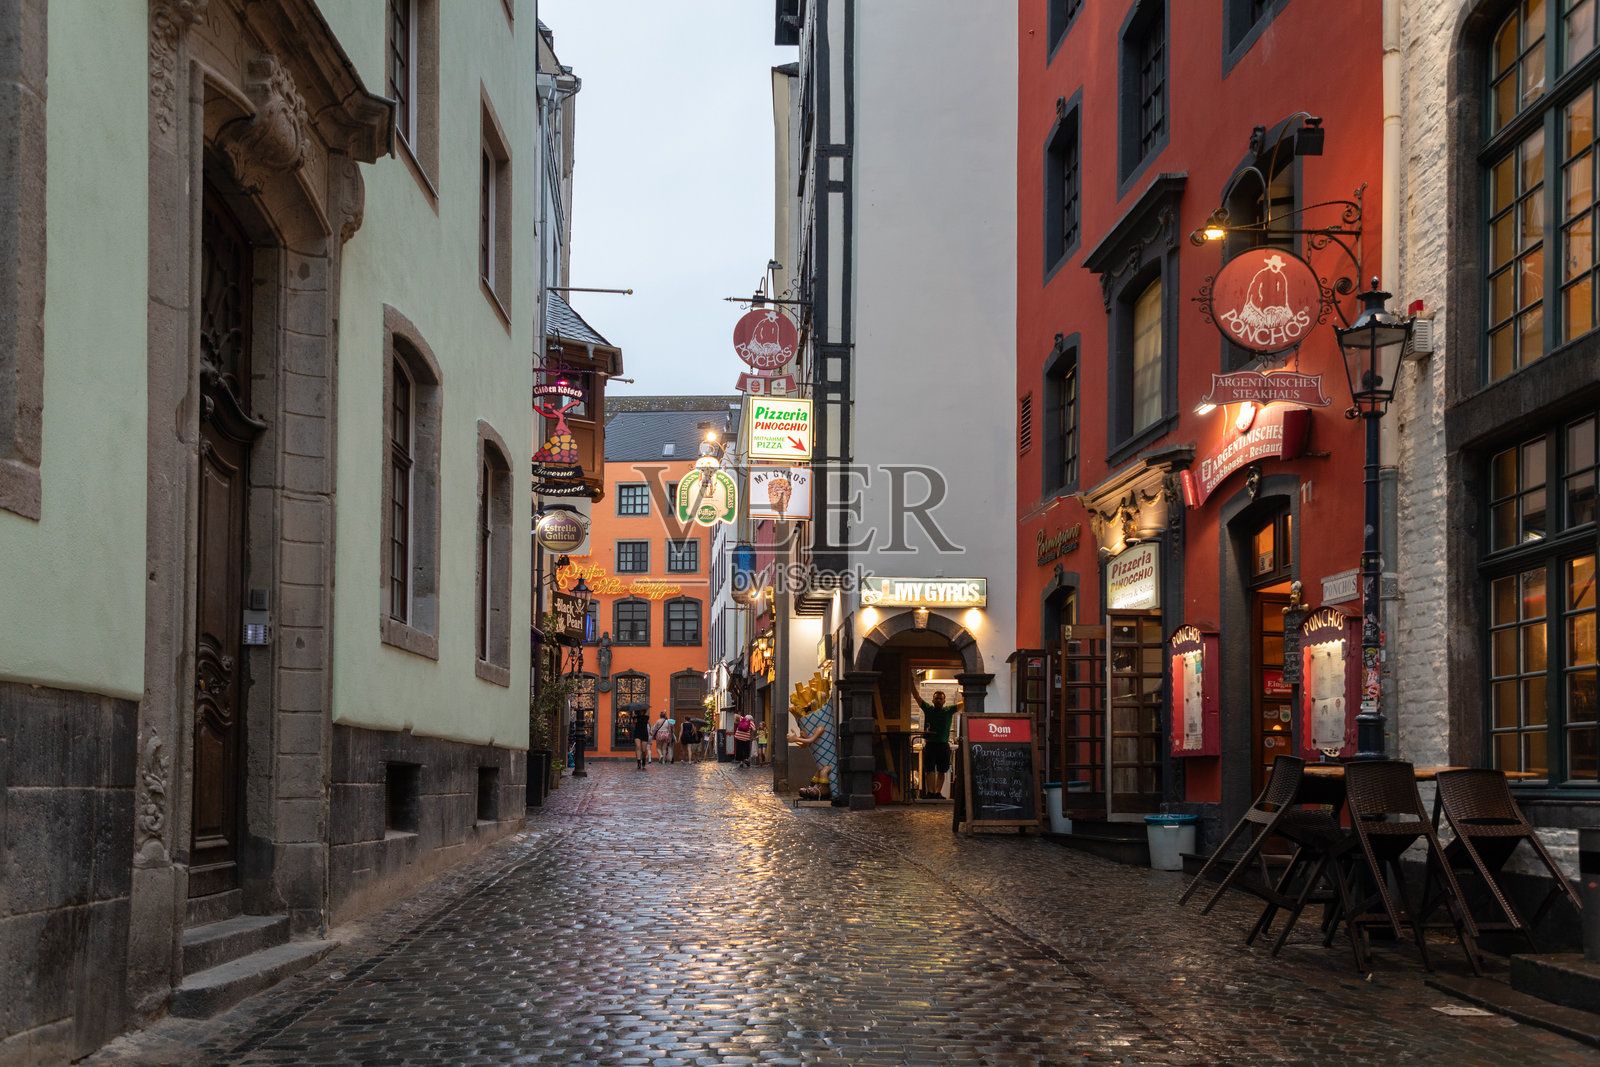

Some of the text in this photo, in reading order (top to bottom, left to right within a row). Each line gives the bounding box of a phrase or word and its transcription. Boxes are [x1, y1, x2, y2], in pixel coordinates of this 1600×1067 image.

[1216, 377, 1317, 388] ARGENTINISCHES
[1232, 389, 1300, 400] STEAKHAUS
[755, 406, 808, 421] Pizzeria
[754, 421, 808, 432] PINOCCHIO
[757, 441, 783, 449] PIZZA
[534, 466, 575, 477] Taverna
[754, 469, 807, 485] MY GYROS
[1206, 454, 1244, 493] Steakhouse
[531, 482, 585, 494] lamenca
[1301, 480, 1313, 504] 11
[544, 524, 577, 532] Estrella
[545, 531, 575, 540] Galicia
[1111, 550, 1152, 580] Pizzeria
[1110, 566, 1154, 593] PINOCCHIO
[895, 582, 980, 602] MY GYROS
[554, 598, 576, 618] Black
[566, 613, 583, 630] Pearl
[988, 723, 1011, 734] Dom
